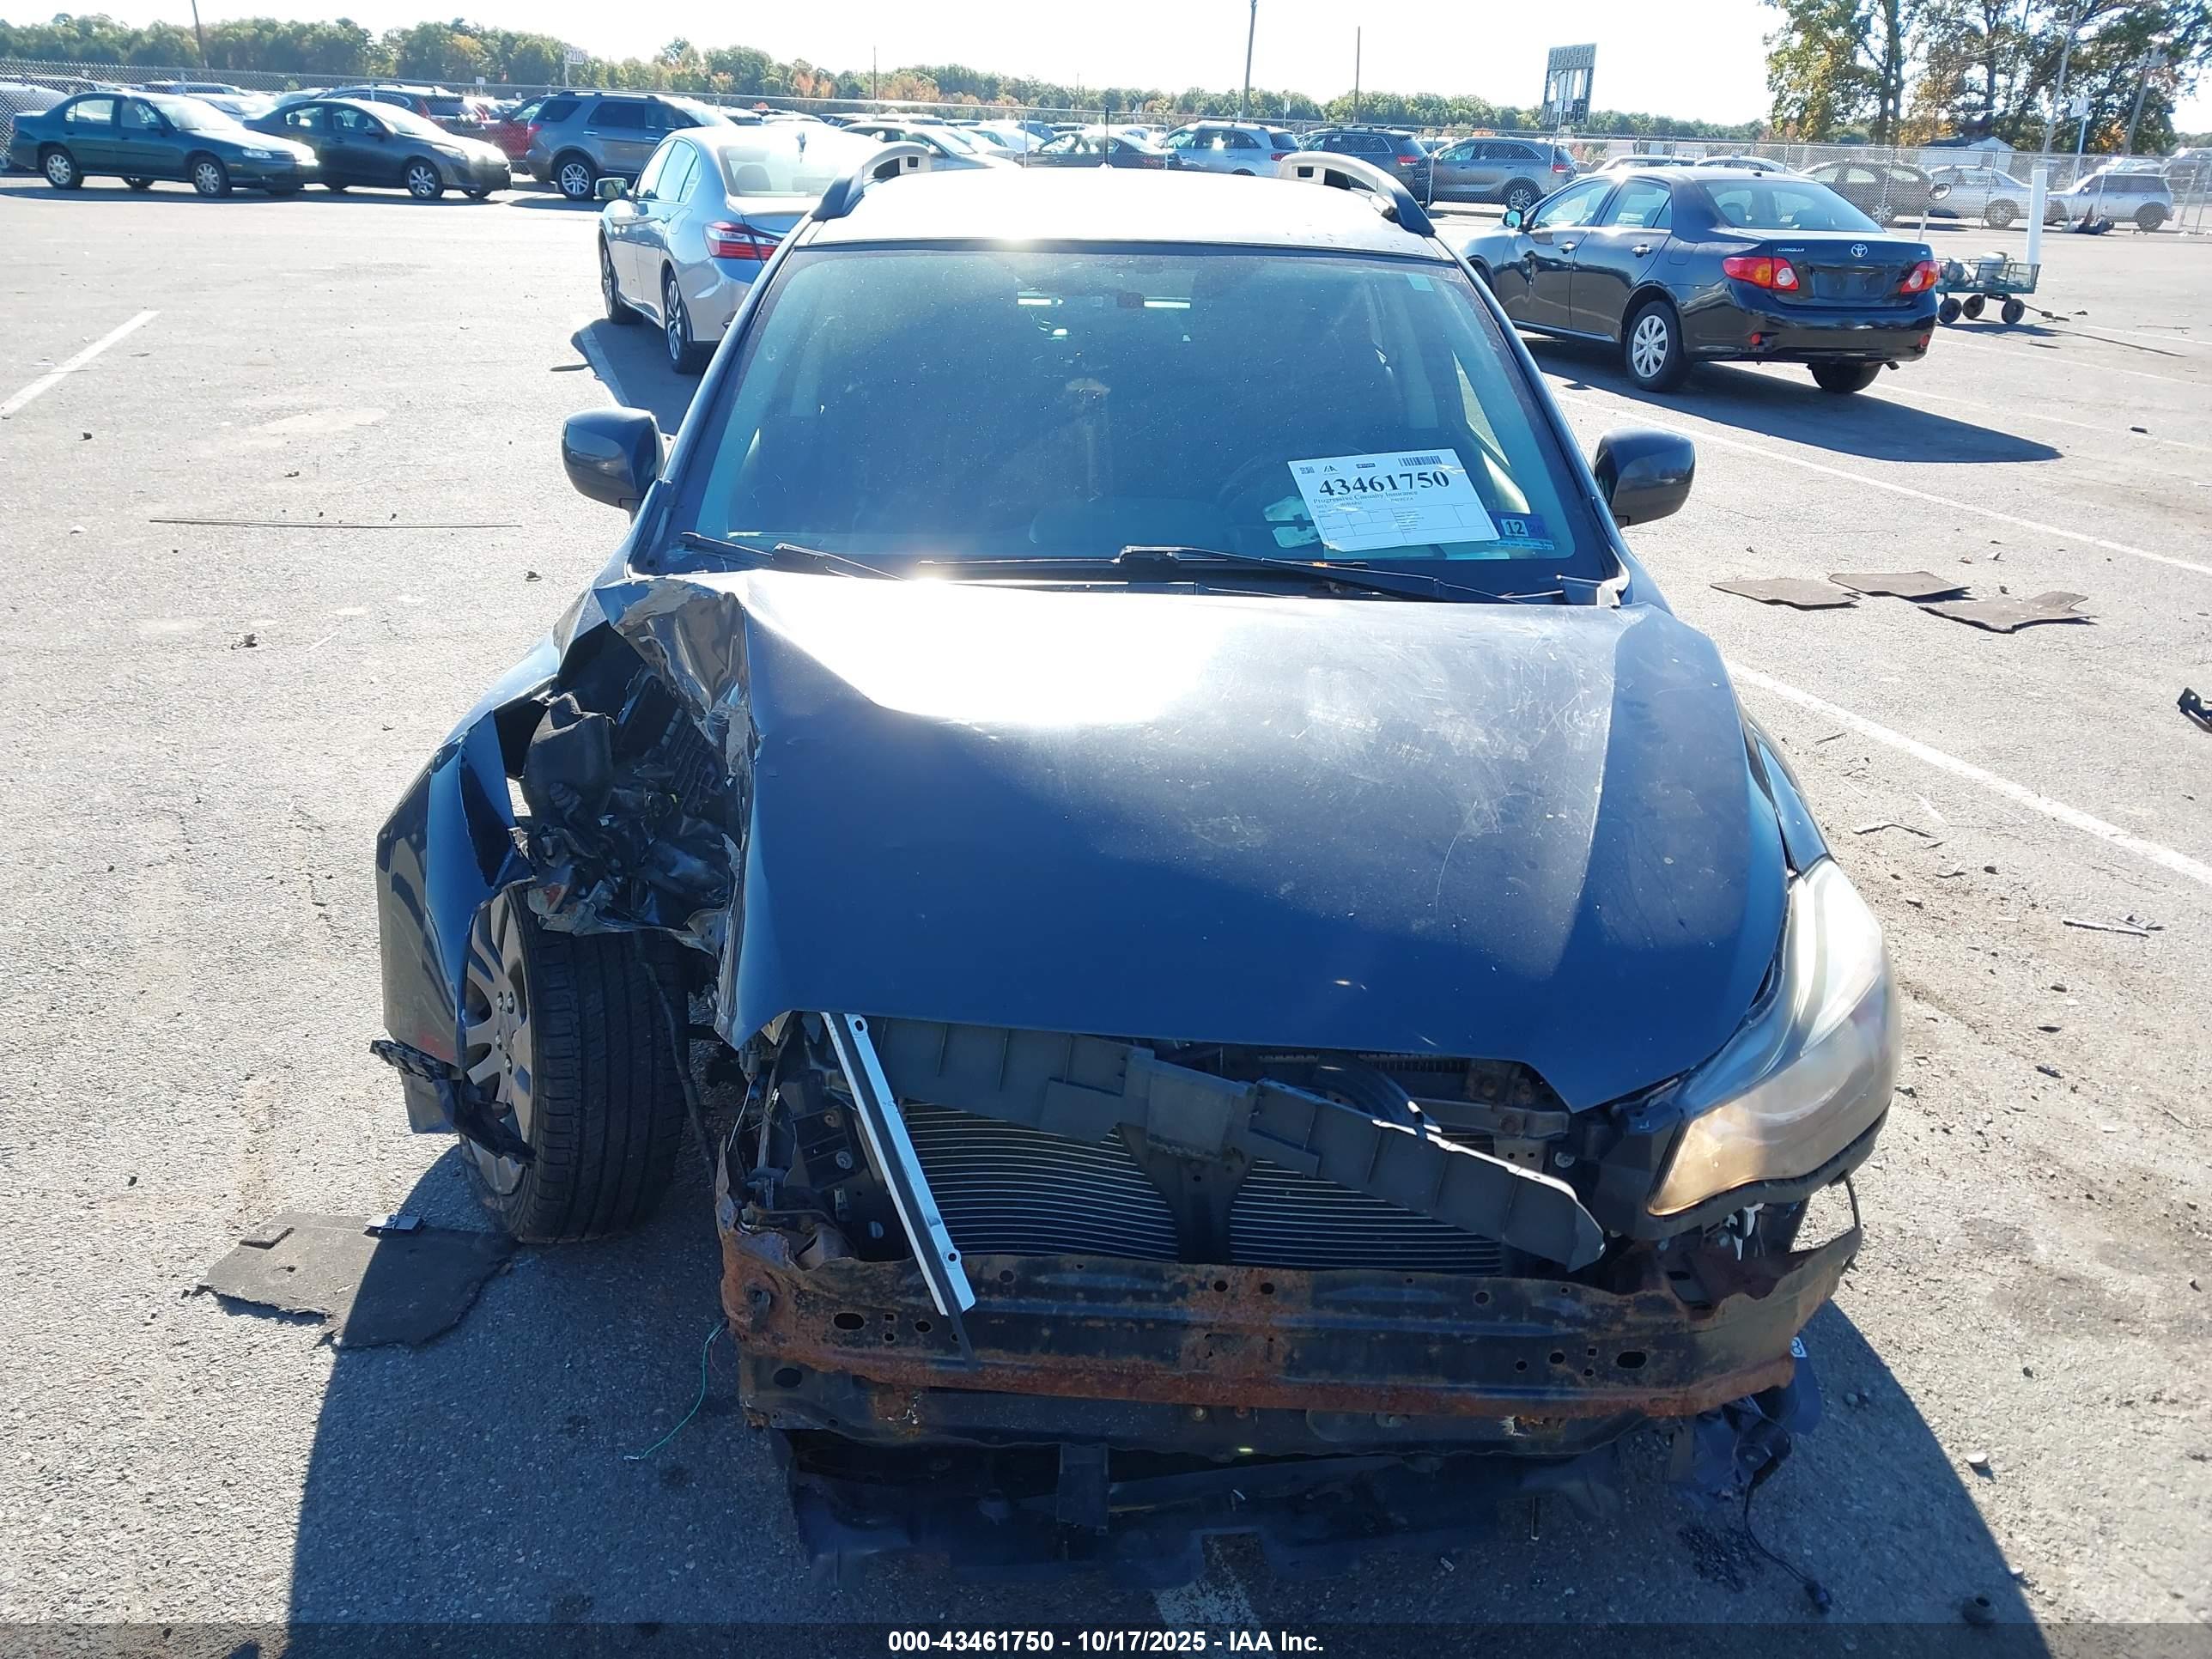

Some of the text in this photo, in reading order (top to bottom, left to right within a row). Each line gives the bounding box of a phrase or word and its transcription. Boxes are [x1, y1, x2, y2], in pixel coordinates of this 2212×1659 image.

[1319, 471, 1449, 496] 43461750
[1313, 495, 1353, 504] Progressive
[1505, 520, 1525, 535] 12
